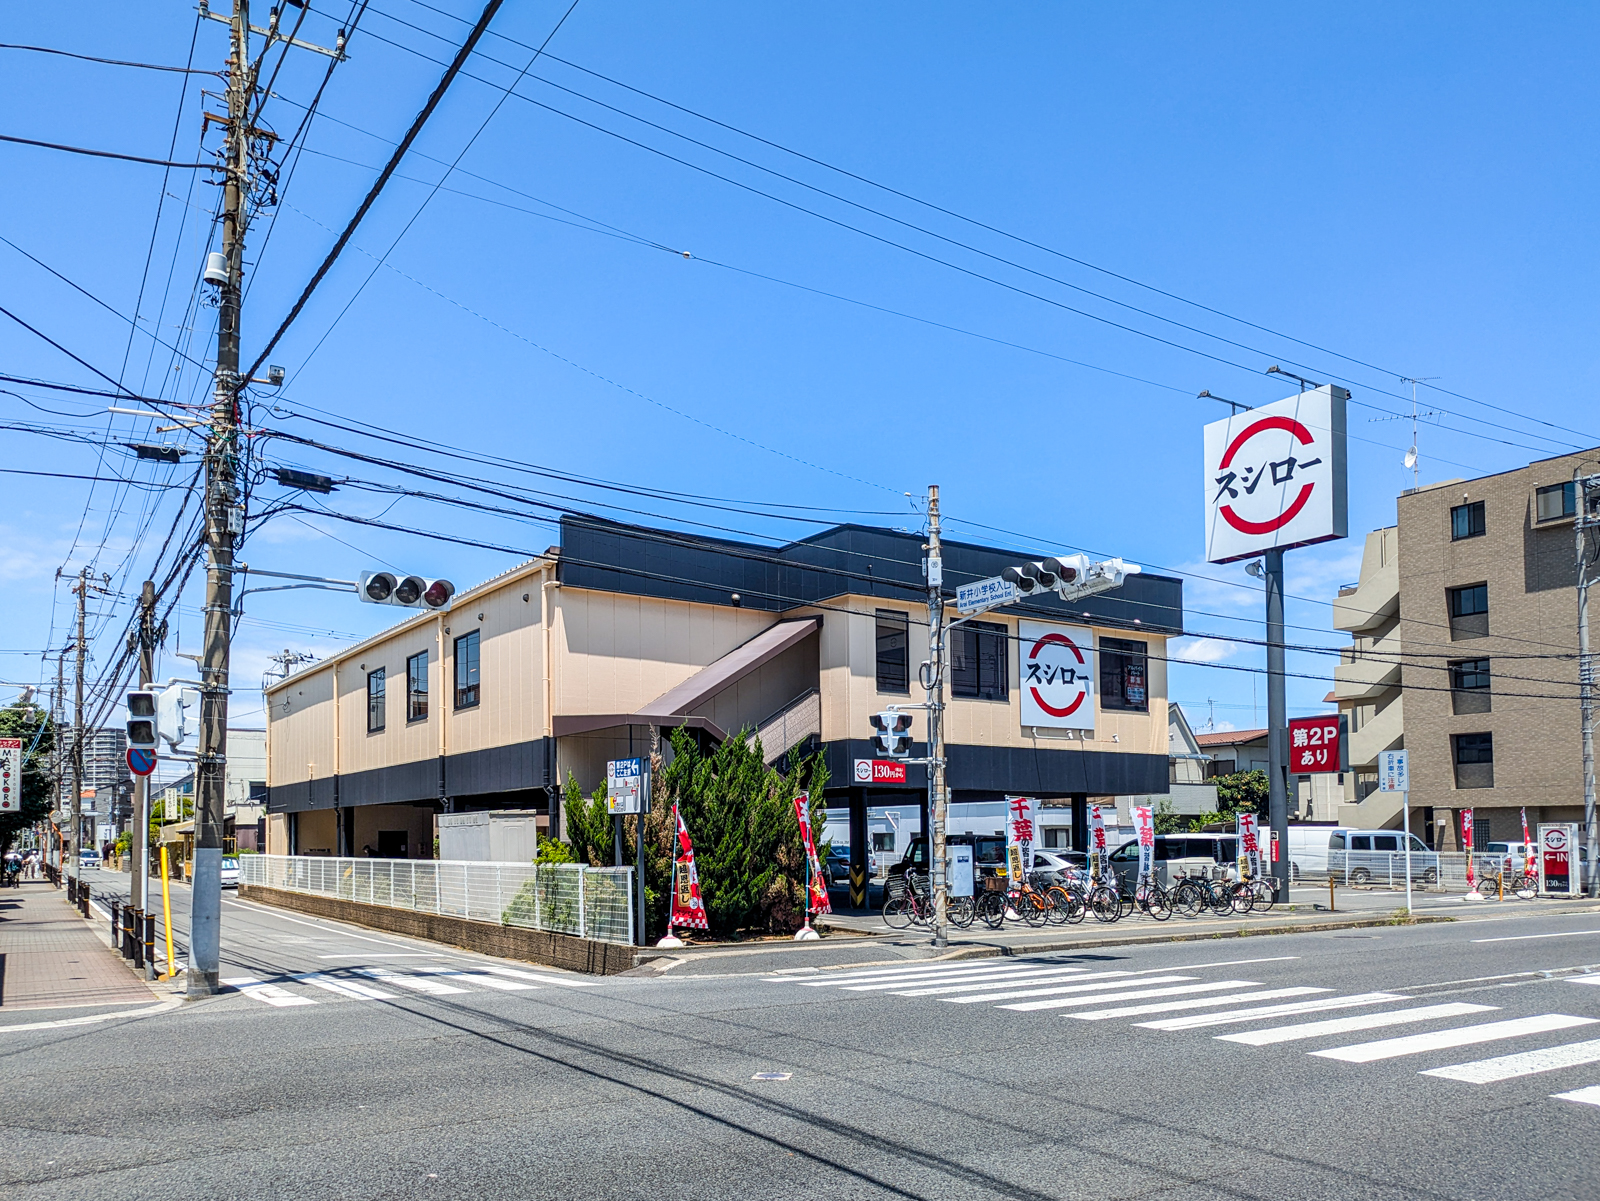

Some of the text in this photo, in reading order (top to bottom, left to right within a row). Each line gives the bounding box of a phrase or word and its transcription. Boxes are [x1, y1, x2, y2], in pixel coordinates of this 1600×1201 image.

[1212, 456, 1322, 504] スシロー
[959, 580, 1012, 601] 新井小学校入口
[968, 597, 990, 606] Elementary
[990, 592, 1004, 601] School
[1025, 663, 1089, 685] スシロー
[1292, 726, 1337, 748] 第2P
[1300, 749, 1327, 766] あり
[1556, 853, 1568, 862] IN
